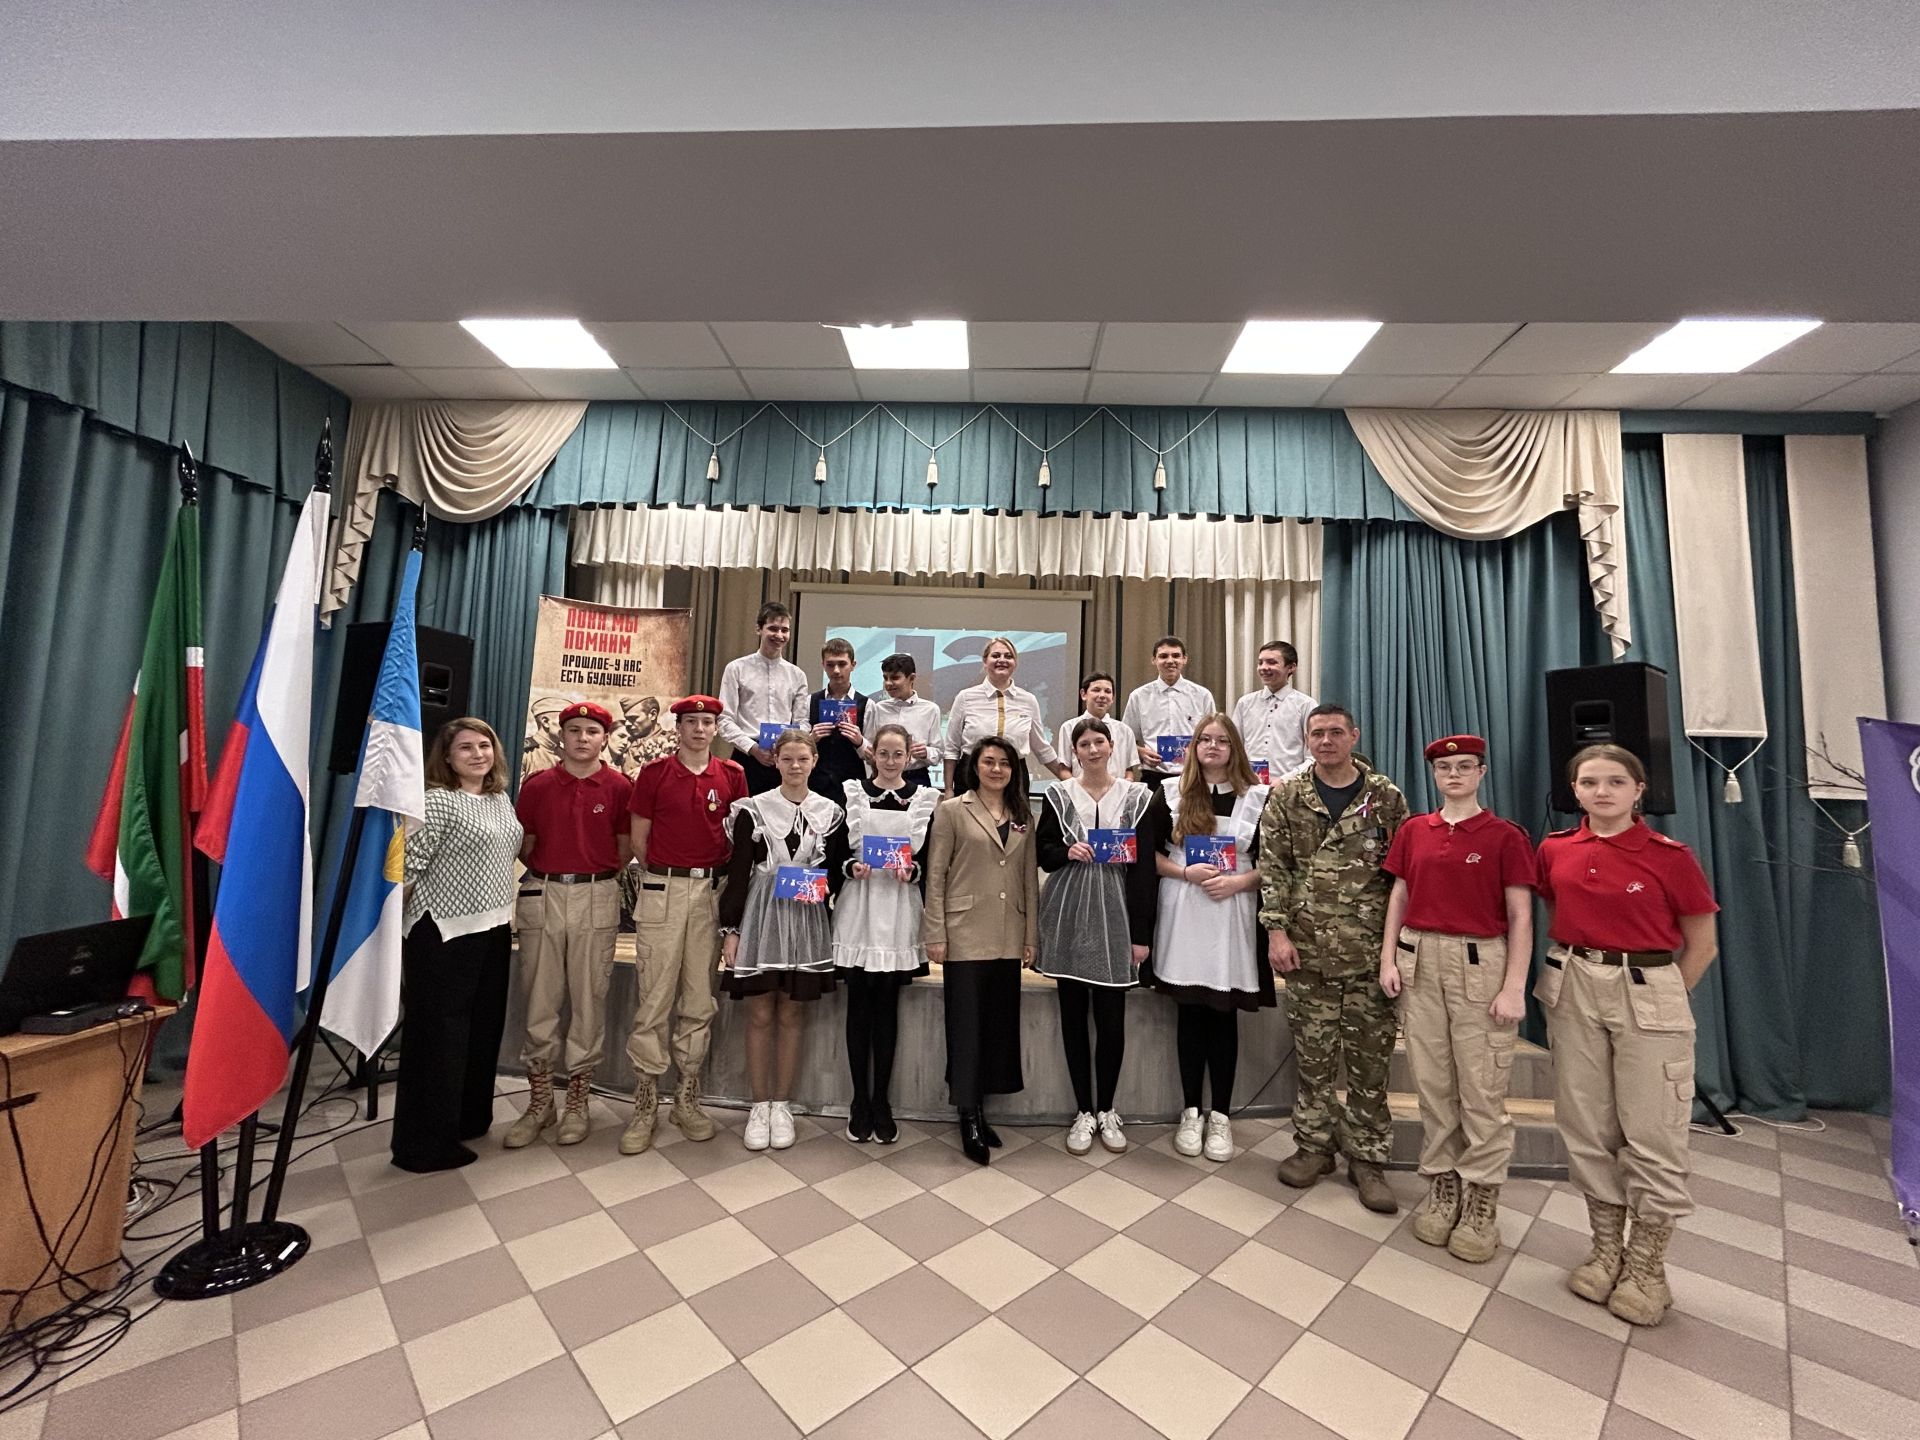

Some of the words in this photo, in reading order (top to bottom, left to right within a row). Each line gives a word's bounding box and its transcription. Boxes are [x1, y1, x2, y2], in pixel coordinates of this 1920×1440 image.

[567, 608, 607, 630] ПОКА
[612, 613, 639, 633] МЫ
[564, 629, 631, 654] ПОМНИМ
[623, 659, 642, 672] НАС
[560, 669, 584, 684] ЕСТЬ
[587, 671, 636, 687] БУДУЩЕЕ!
